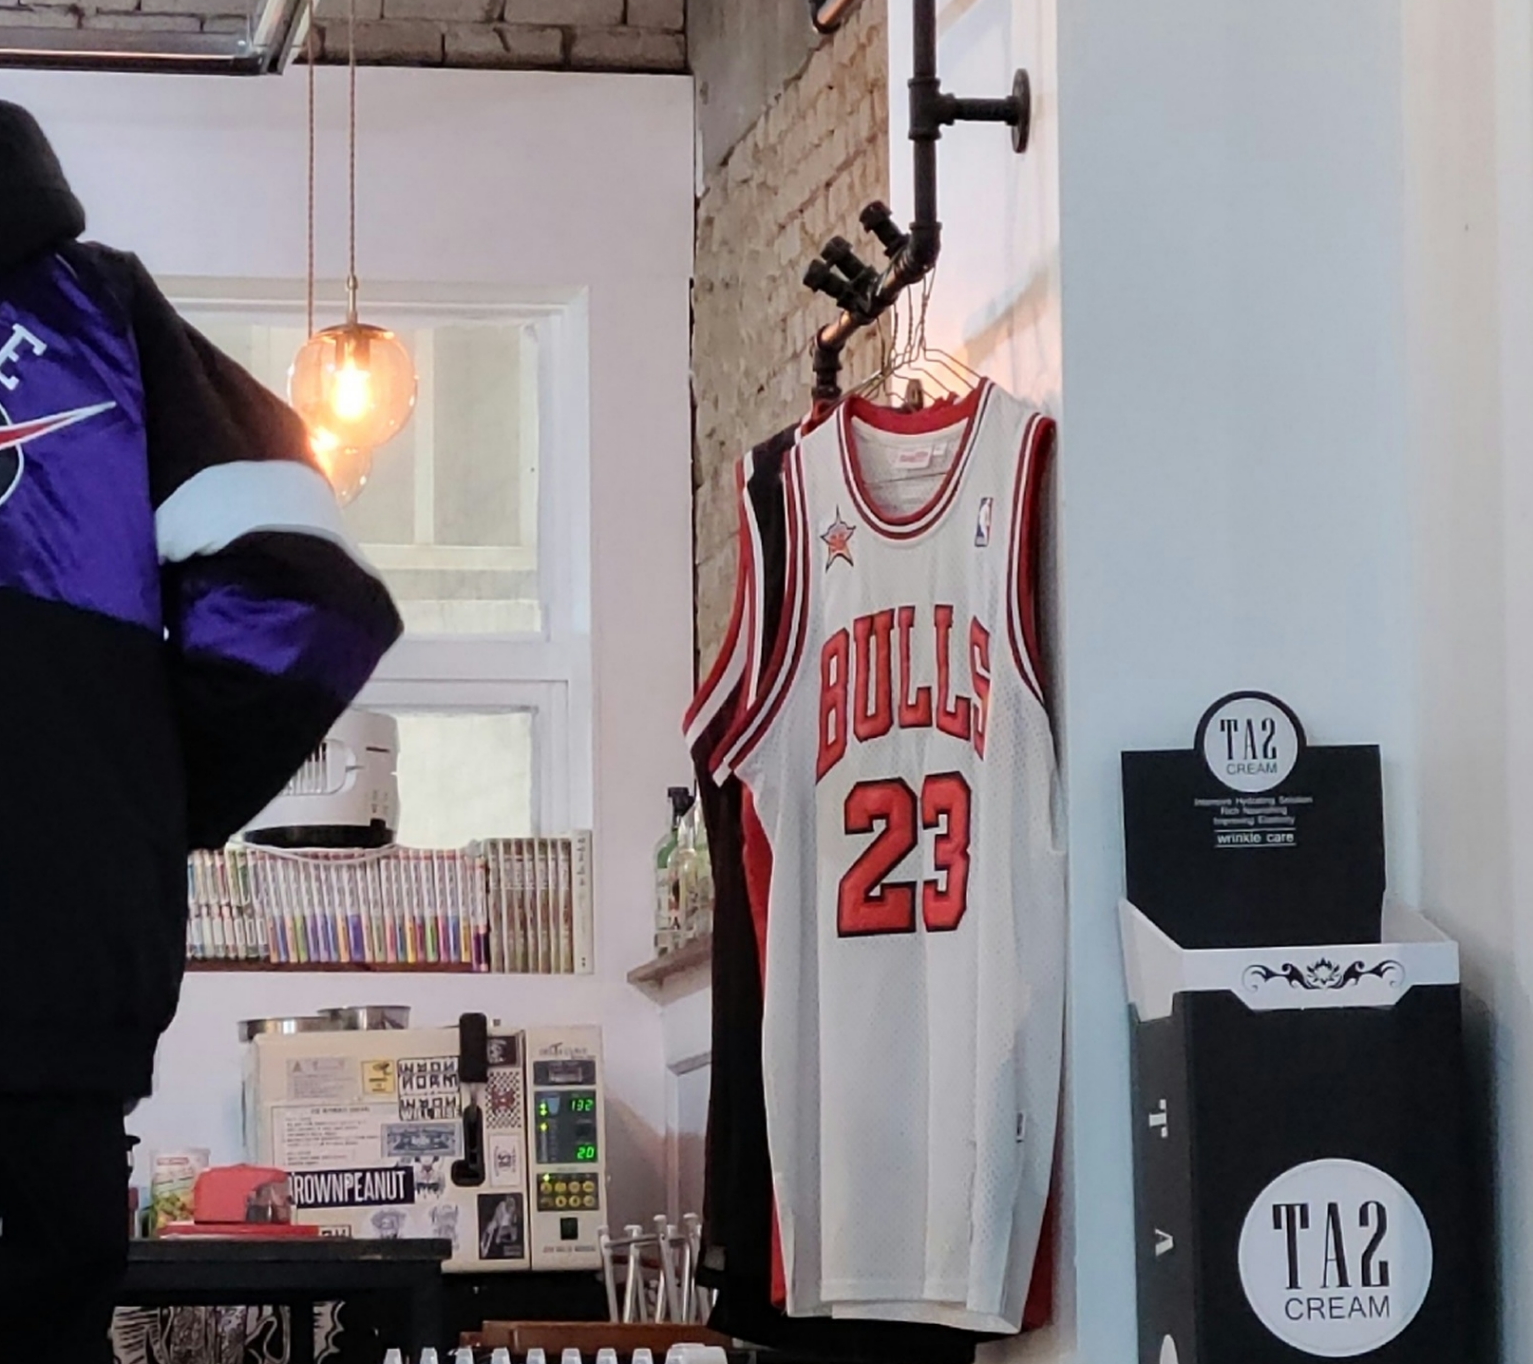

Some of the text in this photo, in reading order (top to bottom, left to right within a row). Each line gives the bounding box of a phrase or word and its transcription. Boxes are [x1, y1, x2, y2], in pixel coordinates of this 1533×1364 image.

[816, 604, 990, 785] BULLS
[1226, 763, 1277, 775] CREAM
[1217, 833, 1294, 844] wrinkle care
[837, 771, 971, 937] 23
[577, 1146, 595, 1159] 20
[1284, 1295, 1390, 1321] CREAM
